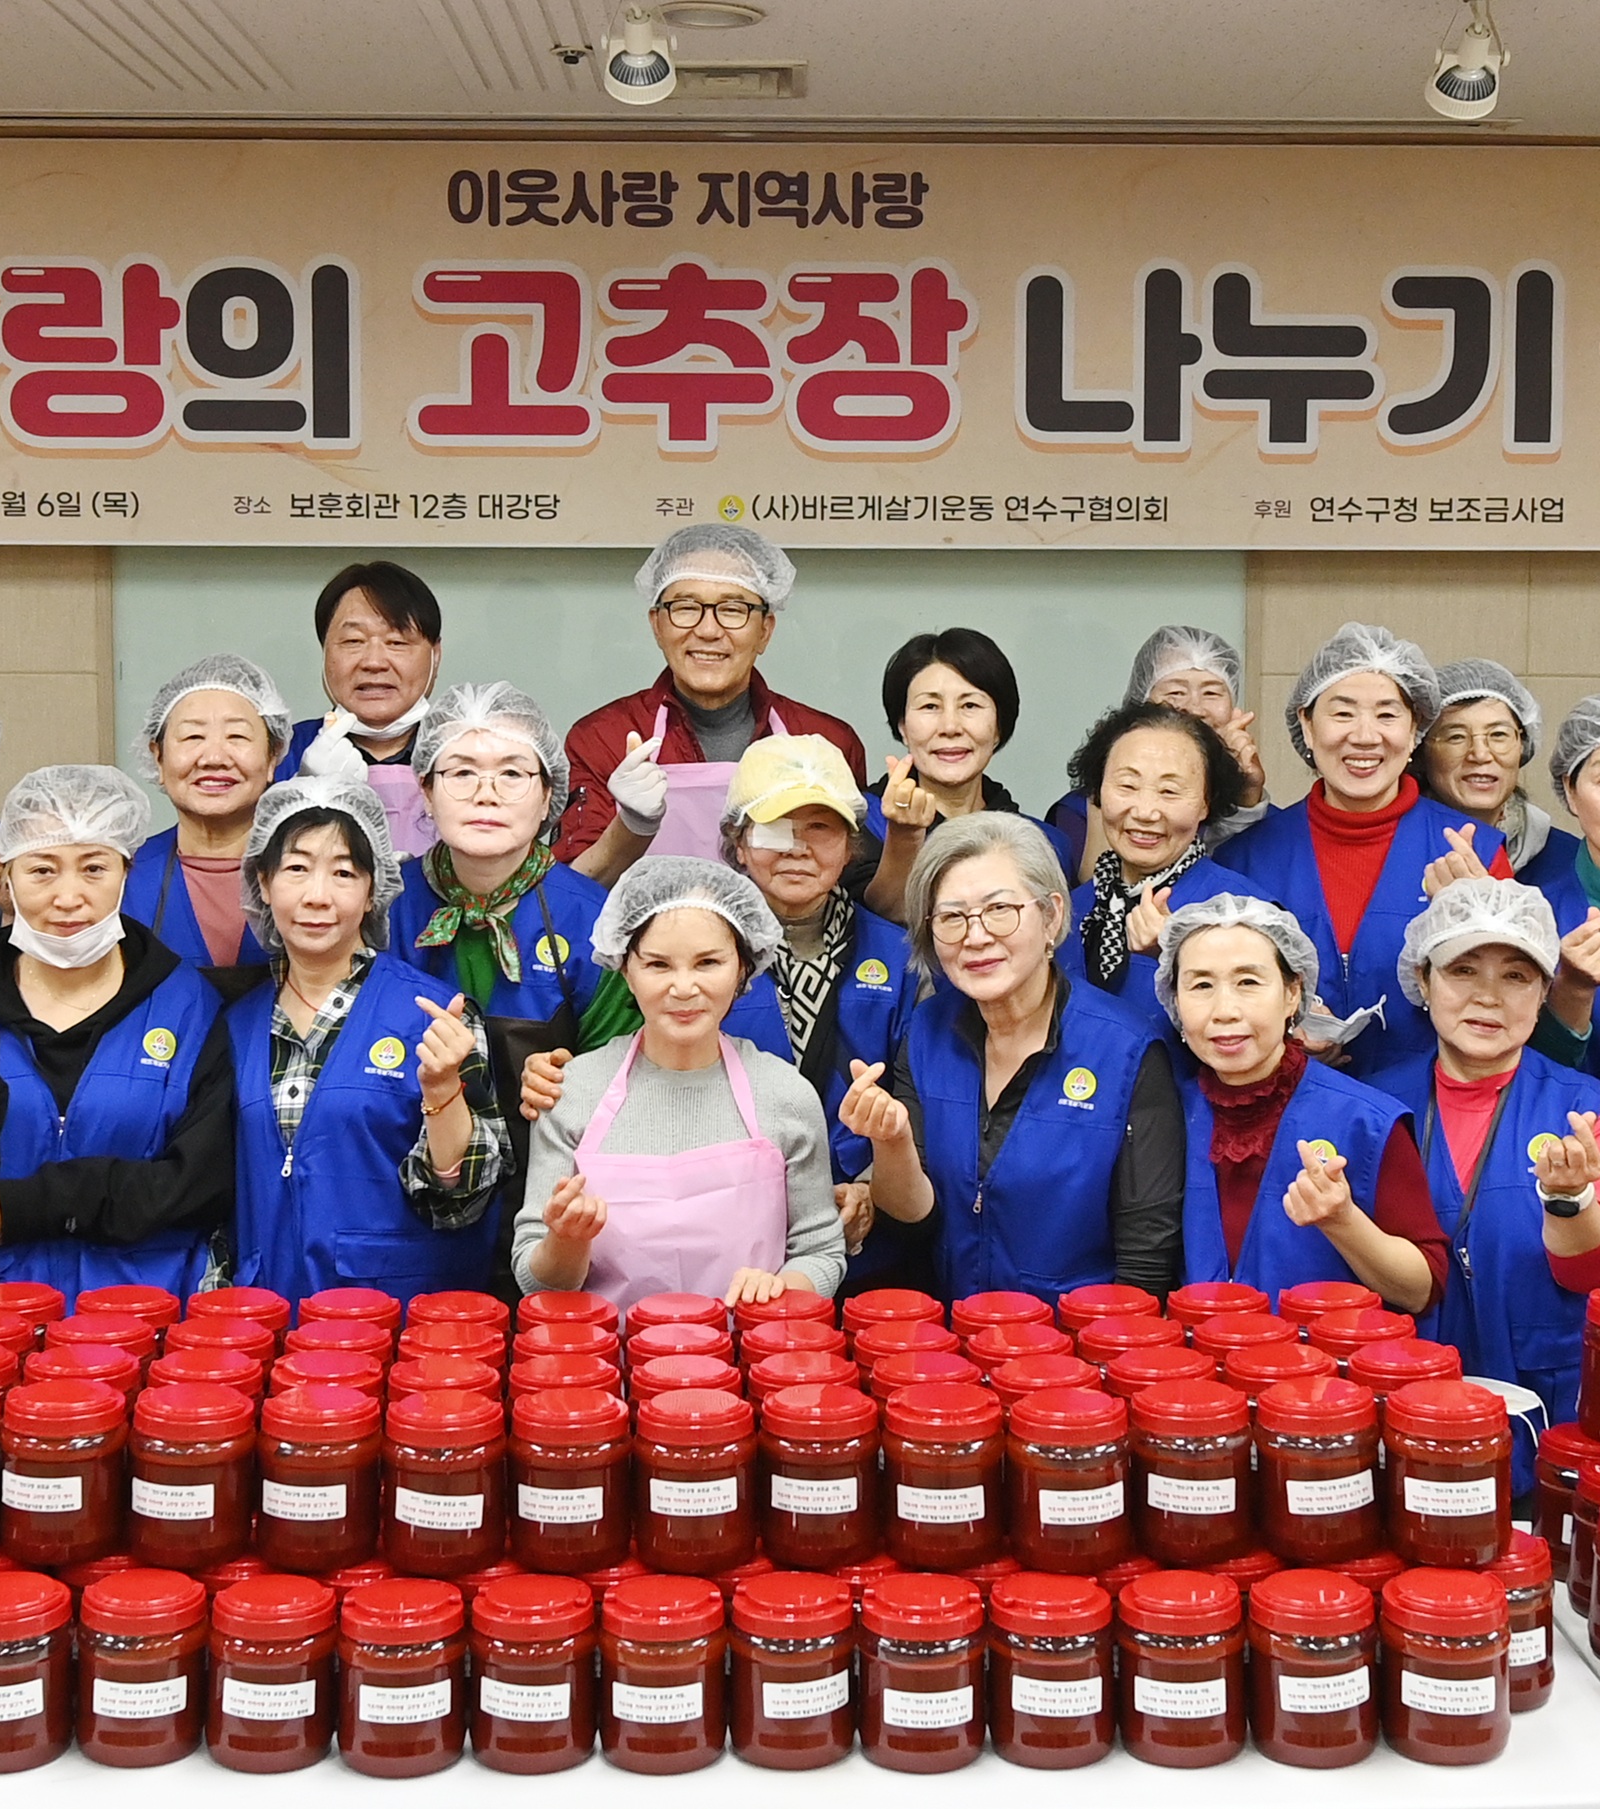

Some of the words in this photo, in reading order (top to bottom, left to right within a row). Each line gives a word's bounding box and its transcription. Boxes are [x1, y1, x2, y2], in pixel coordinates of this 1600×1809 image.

[446, 167, 682, 231] 이웃사랑
[695, 168, 932, 232] 지역사랑
[416, 258, 969, 444] 고추장
[1022, 268, 1558, 446] 나누기
[37, 490, 84, 520] 6일
[90, 490, 143, 522] (목)
[233, 495, 274, 517] 장소
[289, 491, 403, 522] 보훈회관
[409, 492, 471, 523] 12층
[478, 493, 563, 523] 대강당
[655, 497, 697, 519] 주관
[750, 493, 996, 525] (사)바르게살기운동
[1004, 495, 1171, 525] 연수구협의회
[1254, 499, 1294, 522] 후원
[1310, 496, 1421, 525] 연수구청
[1427, 496, 1566, 526] 보조금사업
